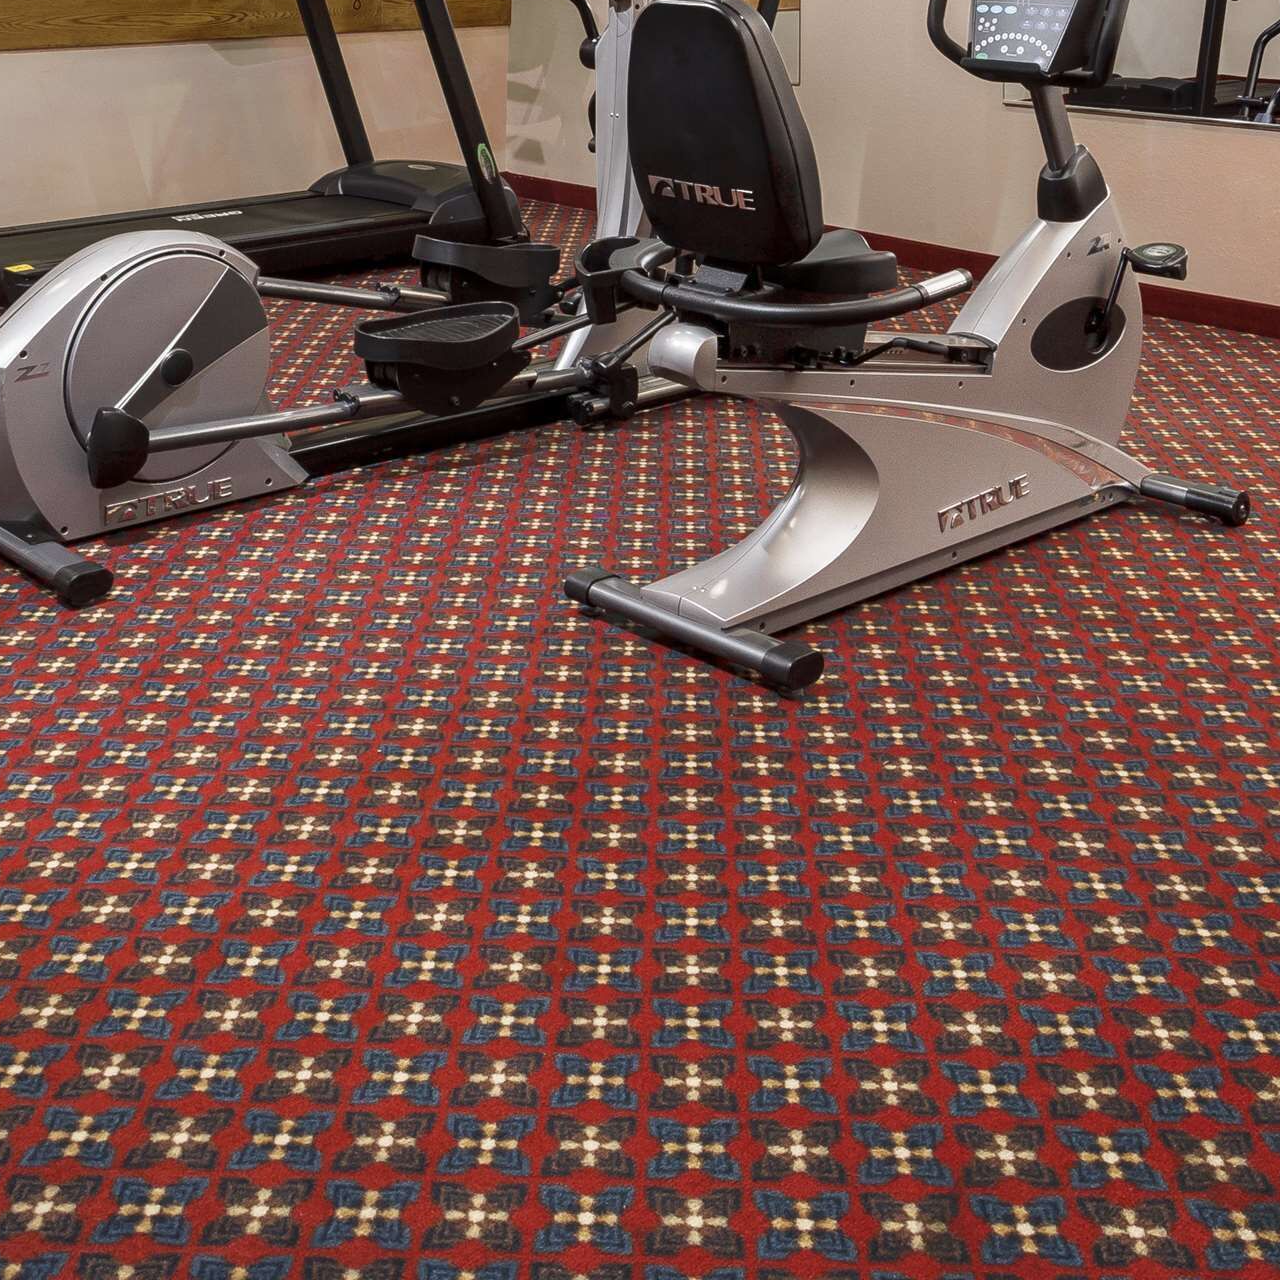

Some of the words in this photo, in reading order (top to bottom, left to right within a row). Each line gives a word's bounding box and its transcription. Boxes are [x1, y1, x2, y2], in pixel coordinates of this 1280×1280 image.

[674, 179, 756, 211] TRUE
[138, 476, 232, 517] TRUE
[962, 473, 1030, 520] TRUE
